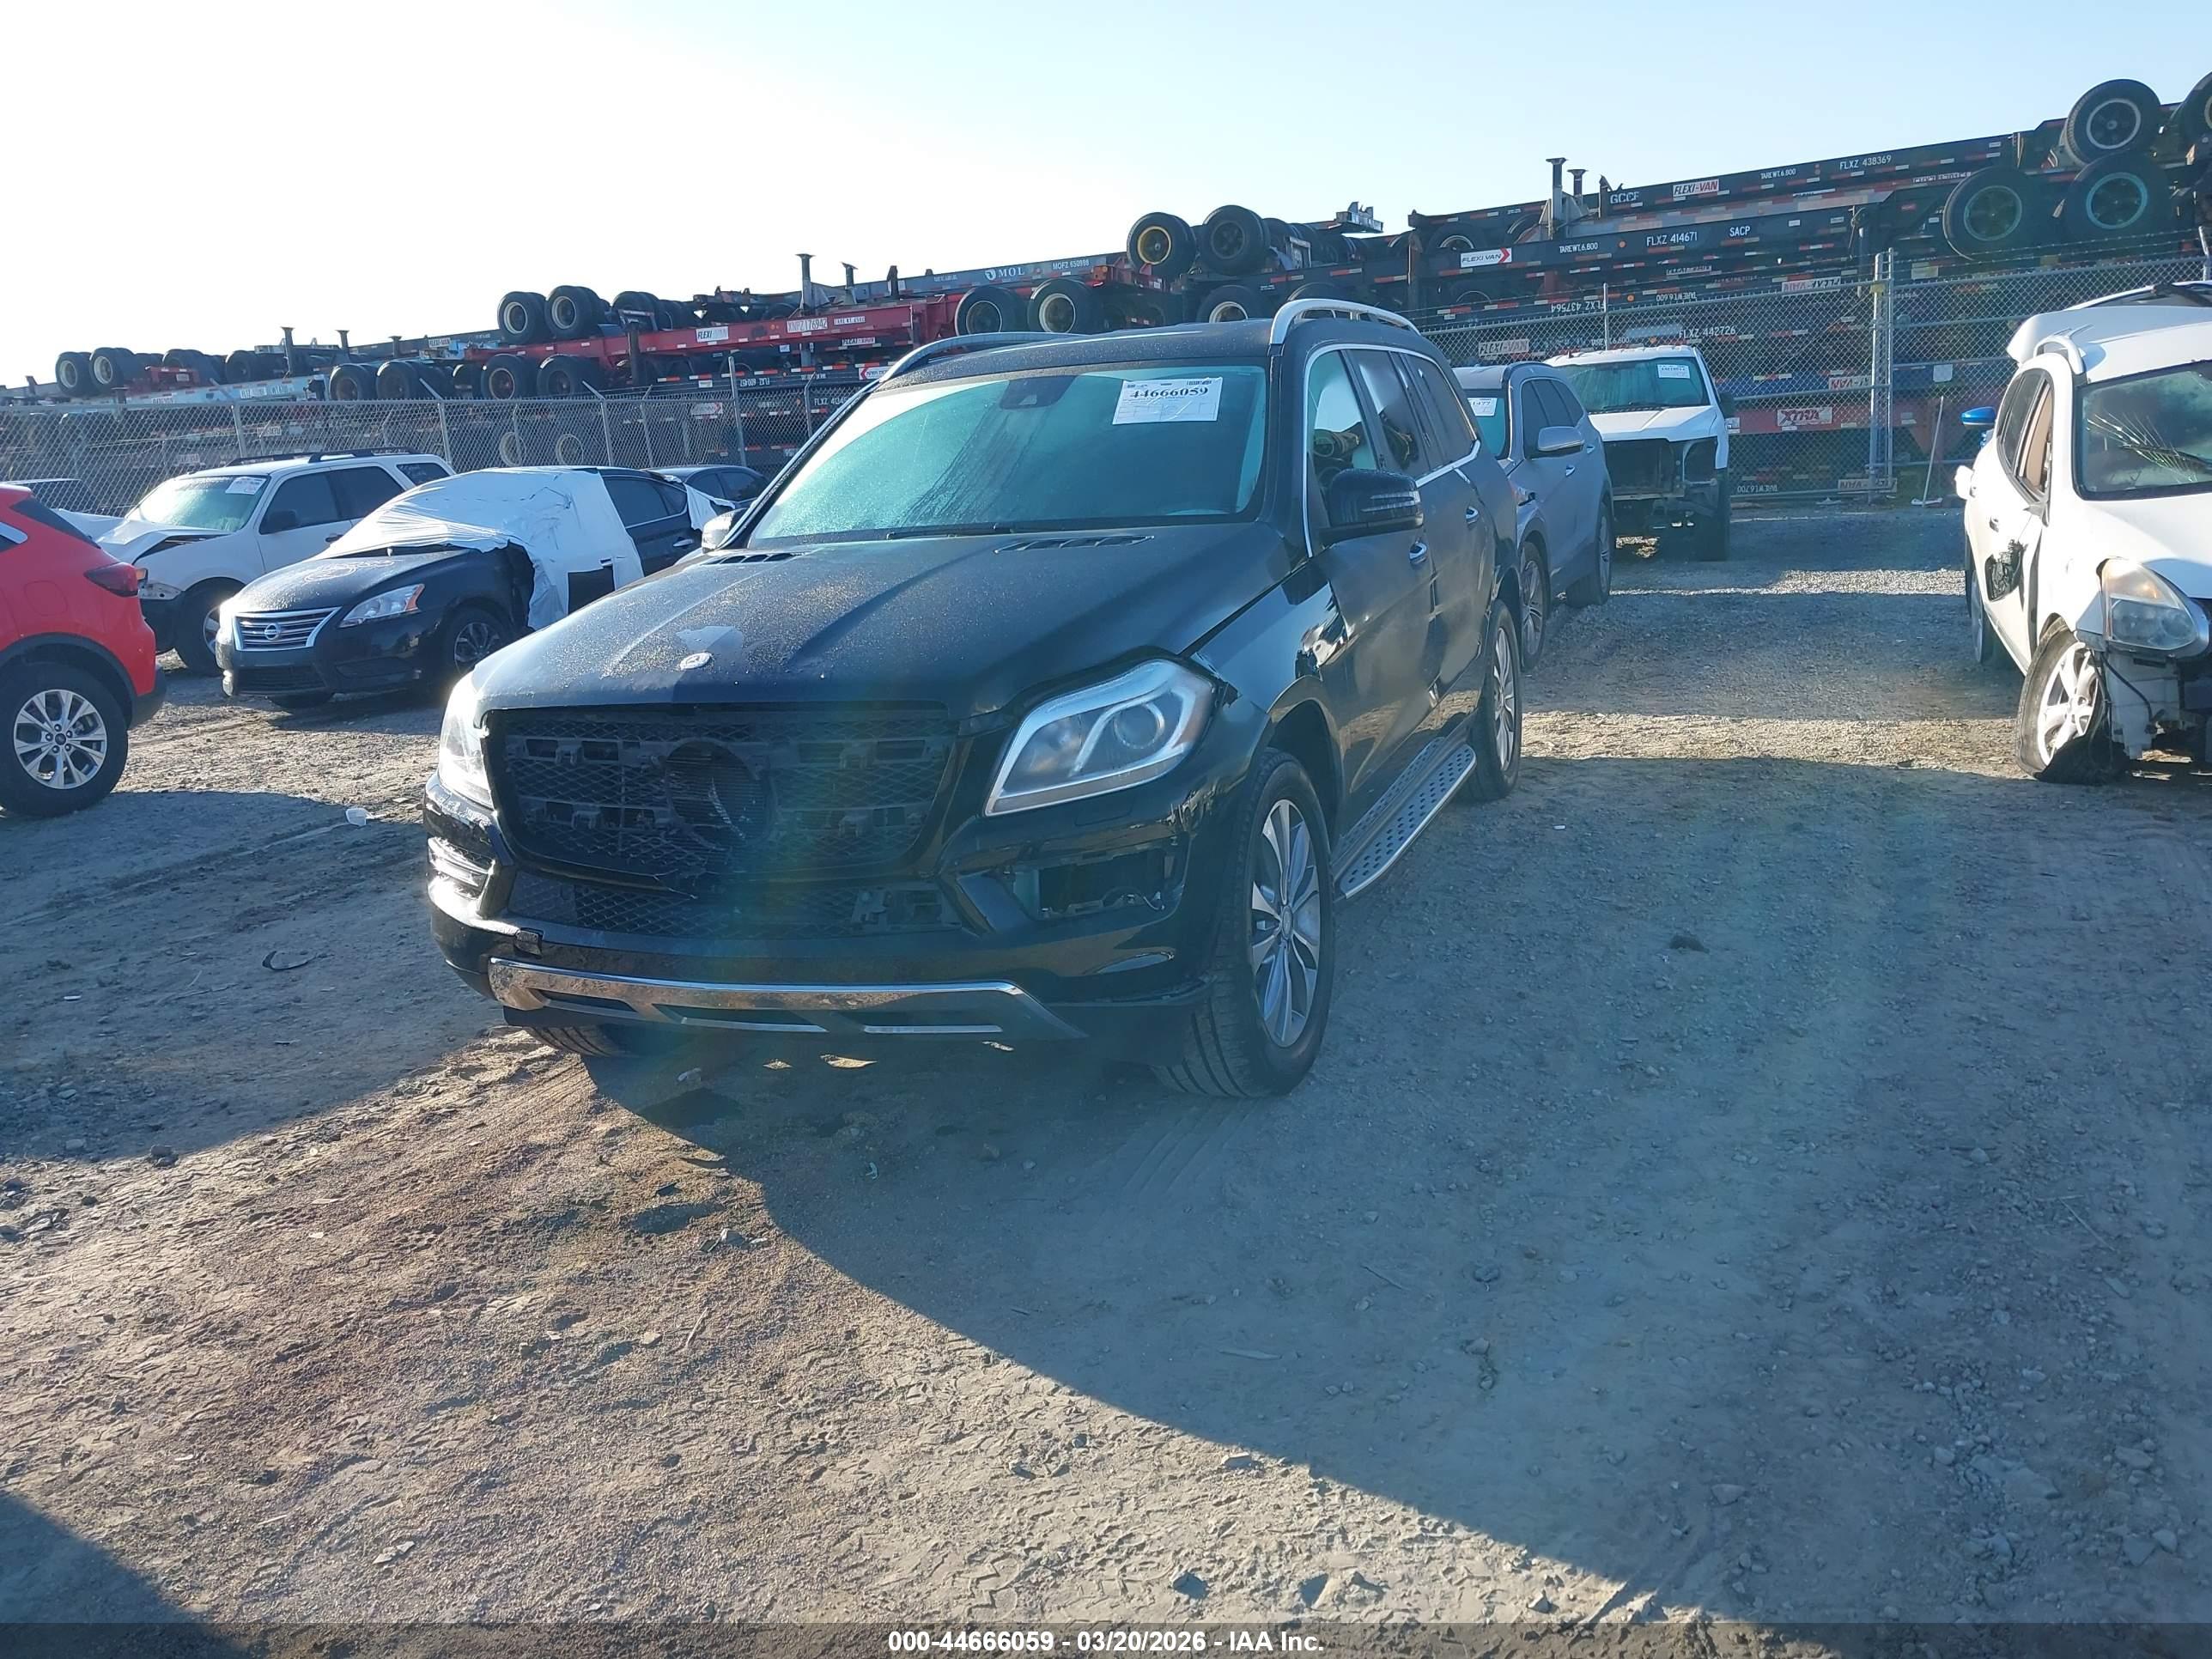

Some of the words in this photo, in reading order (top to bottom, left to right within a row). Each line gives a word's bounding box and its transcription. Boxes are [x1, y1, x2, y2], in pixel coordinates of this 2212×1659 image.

[1839, 160, 1859, 170] FLXZ
[1862, 155, 1892, 166] 438369
[1673, 180, 1717, 195] FLEXI-VAN
[1729, 226, 1751, 237] SACP
[1646, 234, 1667, 246] FLXZ
[1670, 231, 1698, 244] 414671
[1462, 254, 1484, 263] FLEXI
[998, 267, 1024, 278] MOL
[1679, 329, 1699, 338] FLXZ
[1703, 325, 1736, 337] 442726
[1129, 386, 1209, 398] 44666059
